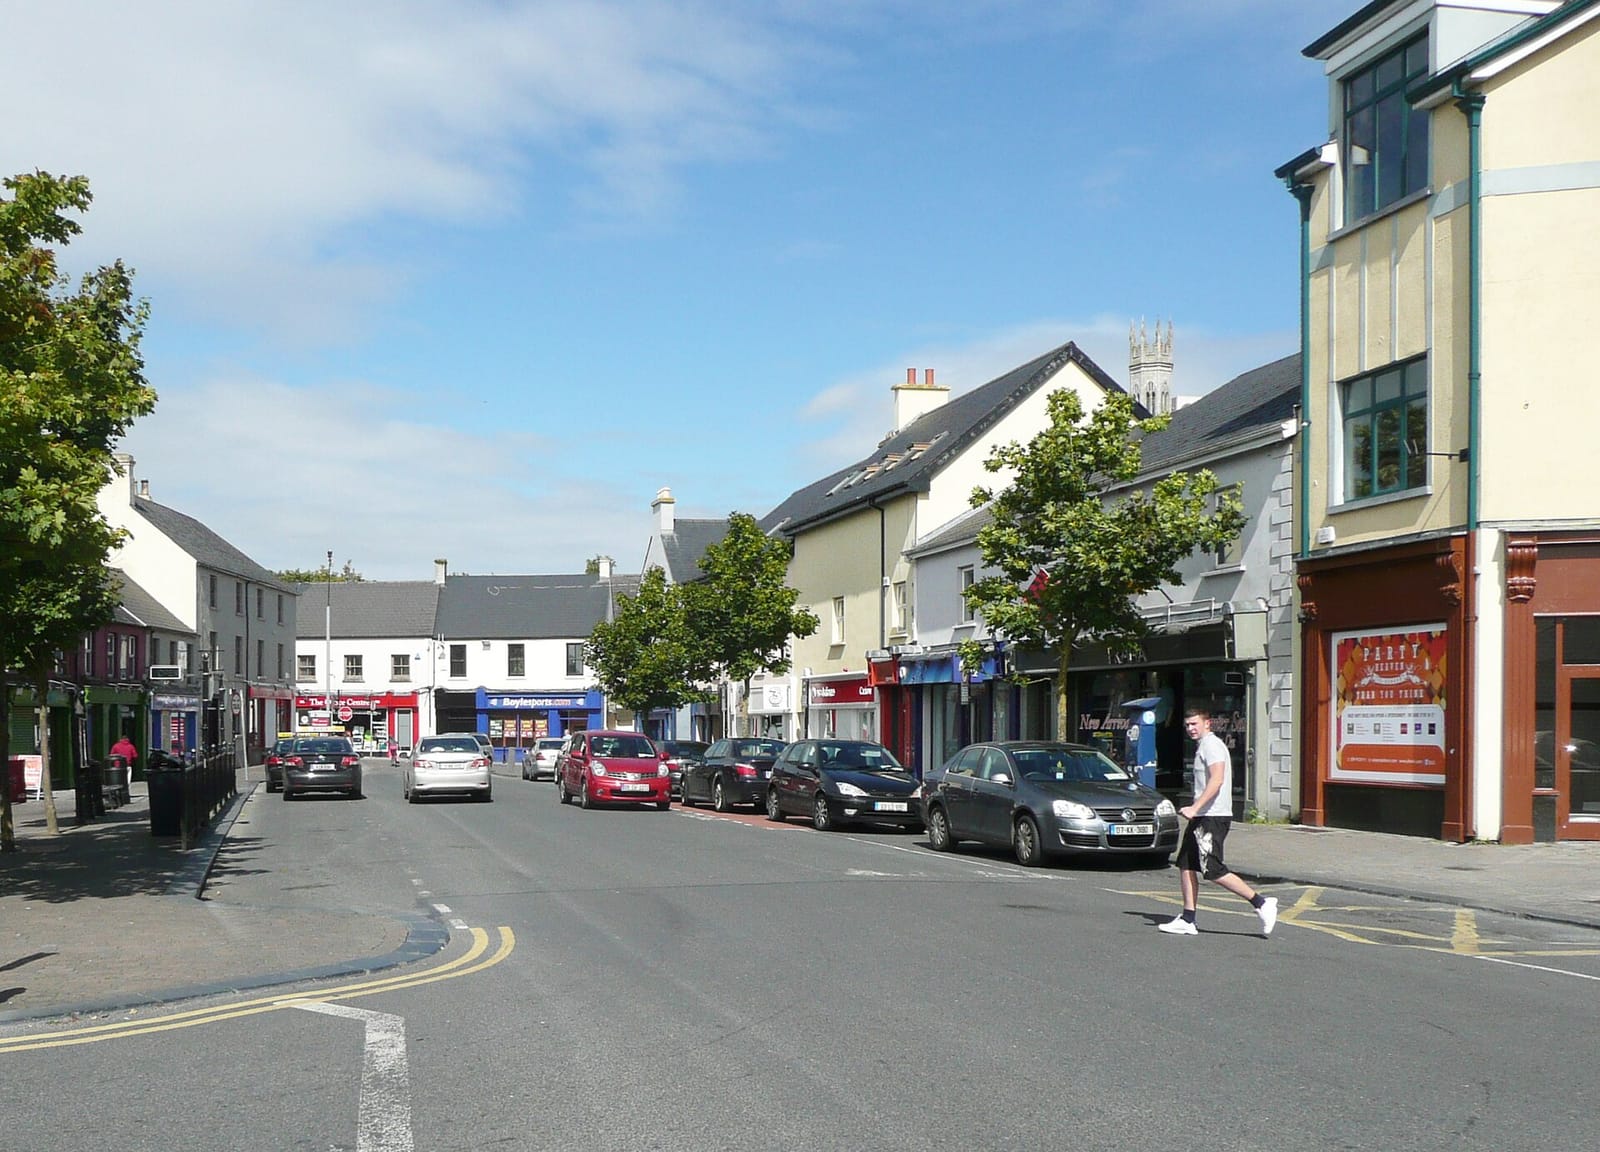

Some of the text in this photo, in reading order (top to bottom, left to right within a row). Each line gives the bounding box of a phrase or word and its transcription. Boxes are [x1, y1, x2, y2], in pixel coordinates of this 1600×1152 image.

[1363, 644, 1419, 662] PARTY
[309, 698, 324, 706] The
[1079, 713, 1101, 730] New
